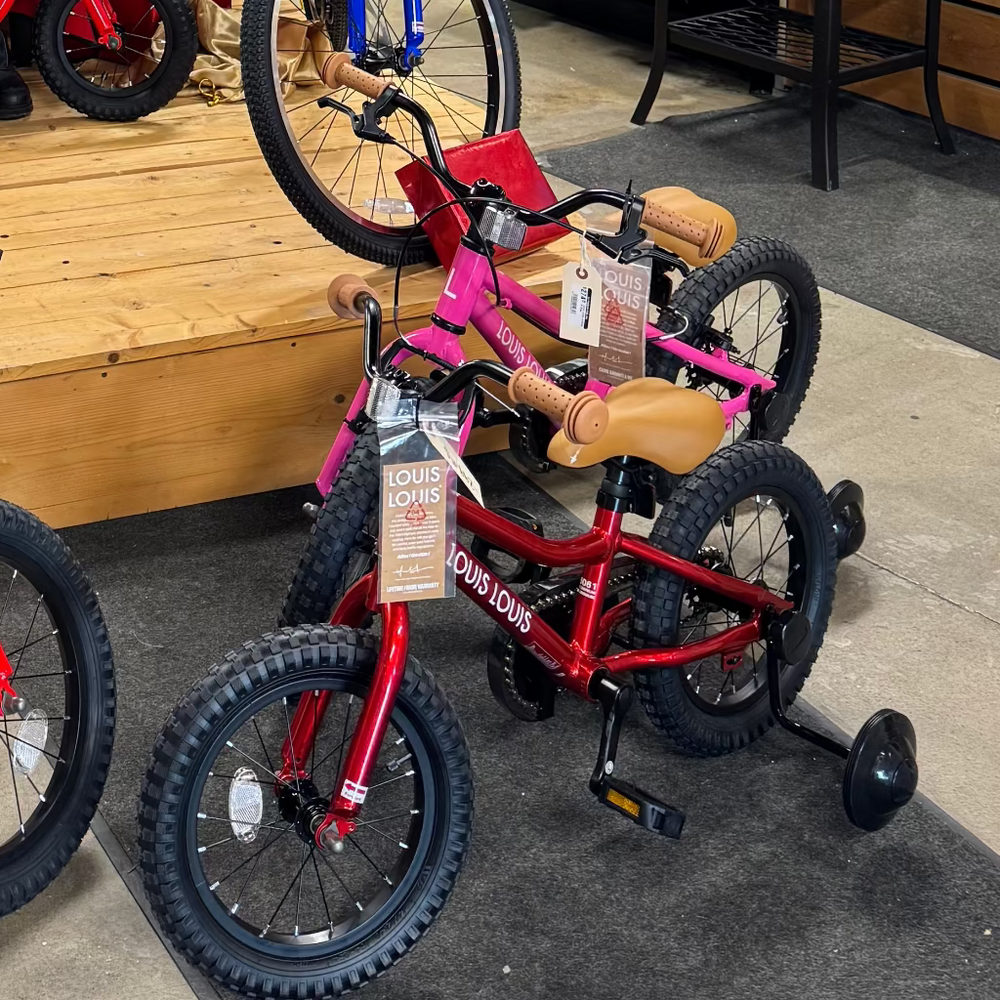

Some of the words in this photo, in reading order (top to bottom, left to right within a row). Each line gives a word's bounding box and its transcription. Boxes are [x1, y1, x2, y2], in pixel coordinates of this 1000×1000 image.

[444, 267, 457, 299] L
[604, 270, 642, 291] OUIS
[602, 287, 640, 309] OUIS
[496, 320, 526, 364] LOUIS
[388, 467, 440, 487] LOUIS
[388, 487, 441, 508] LOUIS
[446, 542, 490, 596] LOUIS
[488, 582, 532, 633] LOUIS
